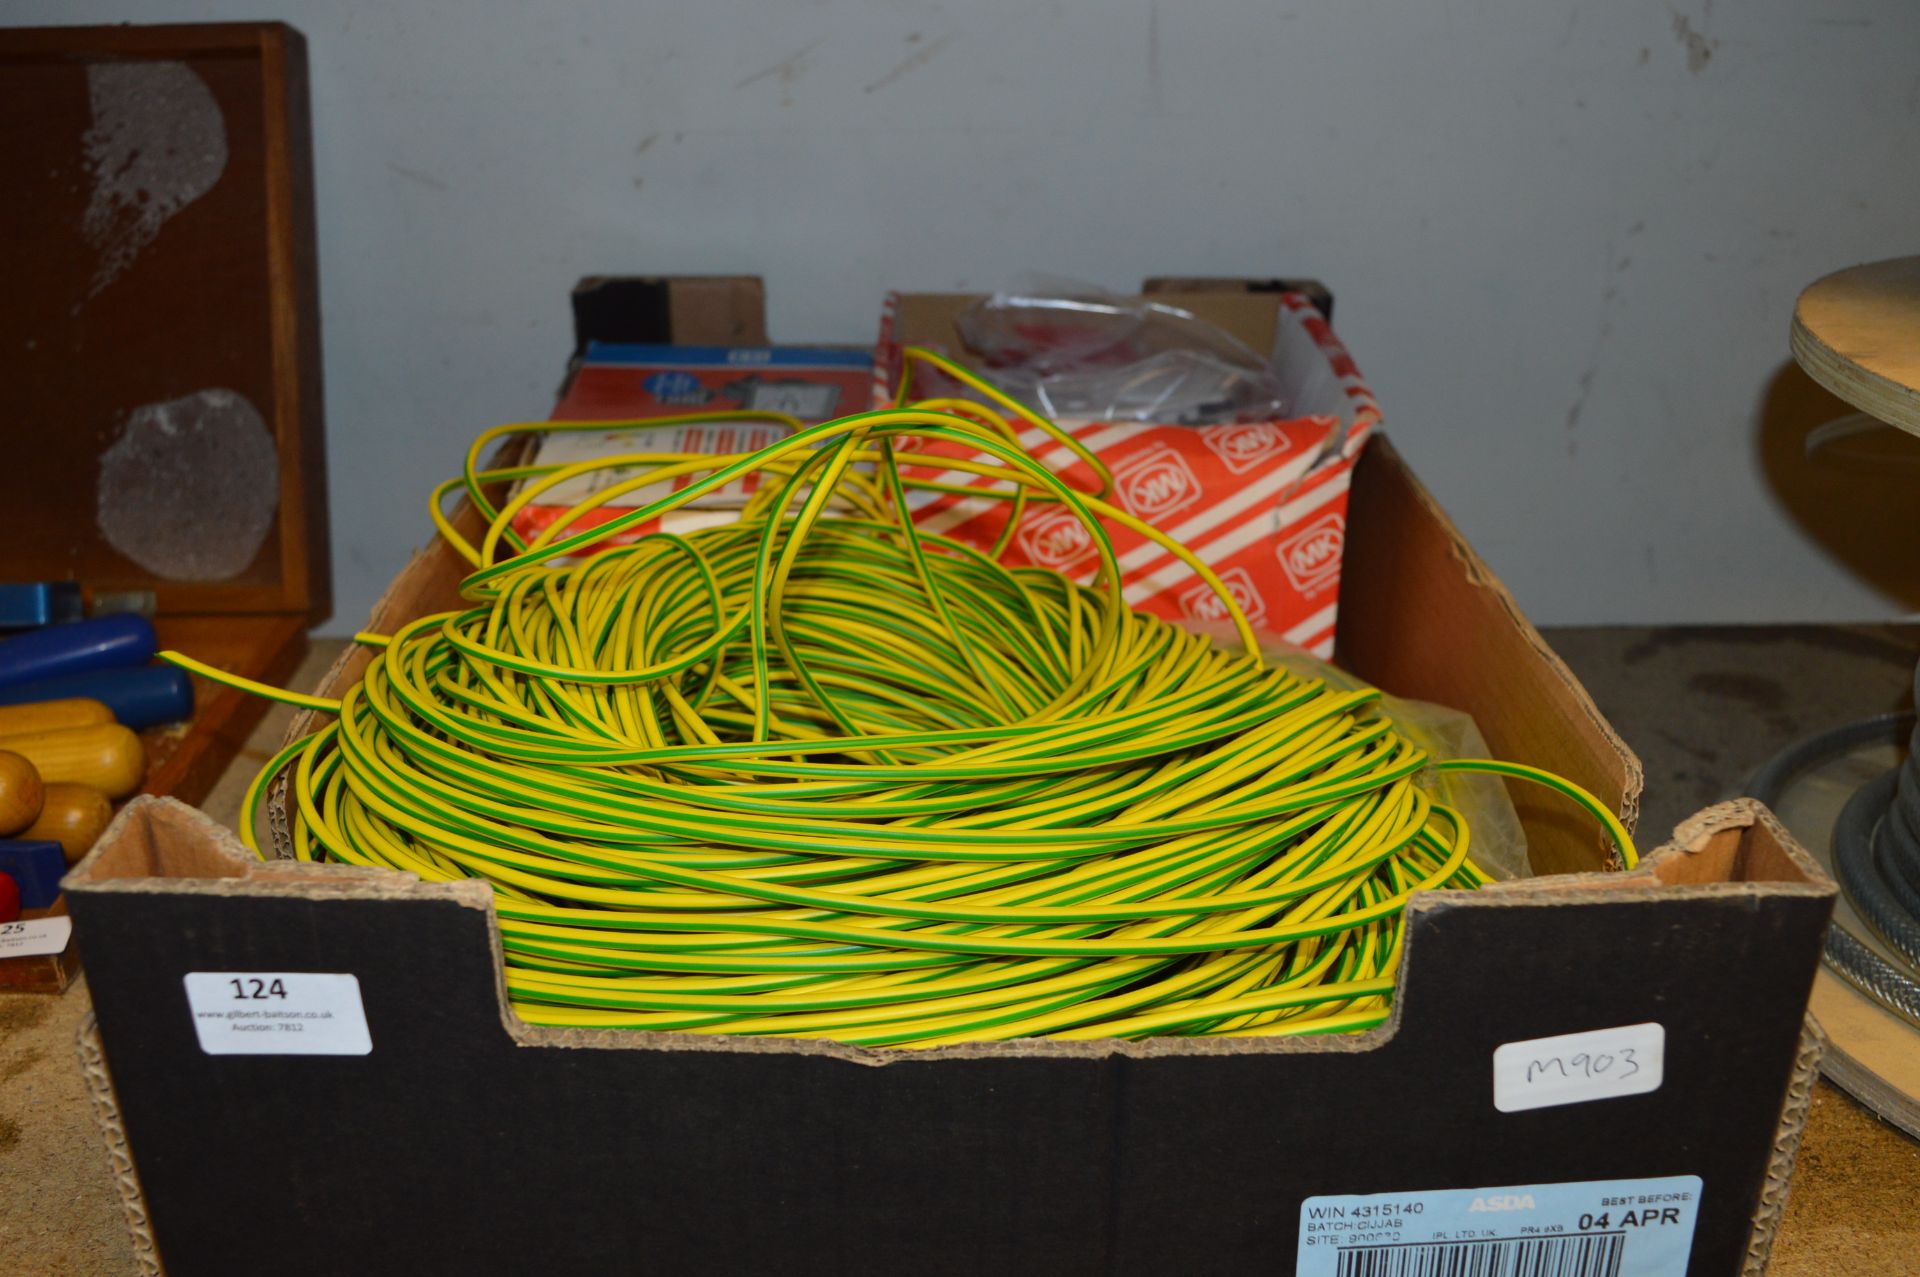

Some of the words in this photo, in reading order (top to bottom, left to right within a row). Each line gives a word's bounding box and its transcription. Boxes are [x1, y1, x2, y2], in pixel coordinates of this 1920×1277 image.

[1292, 534, 1341, 573] MK
[230, 978, 288, 999] 124
[1308, 1206, 1345, 1219] WIN
[1351, 1202, 1424, 1218] 4315140
[1469, 1194, 1535, 1213] ASDA
[1601, 1196, 1634, 1207] BEST
[1579, 1213, 1609, 1230] 04
[1619, 1208, 1680, 1228] APR
